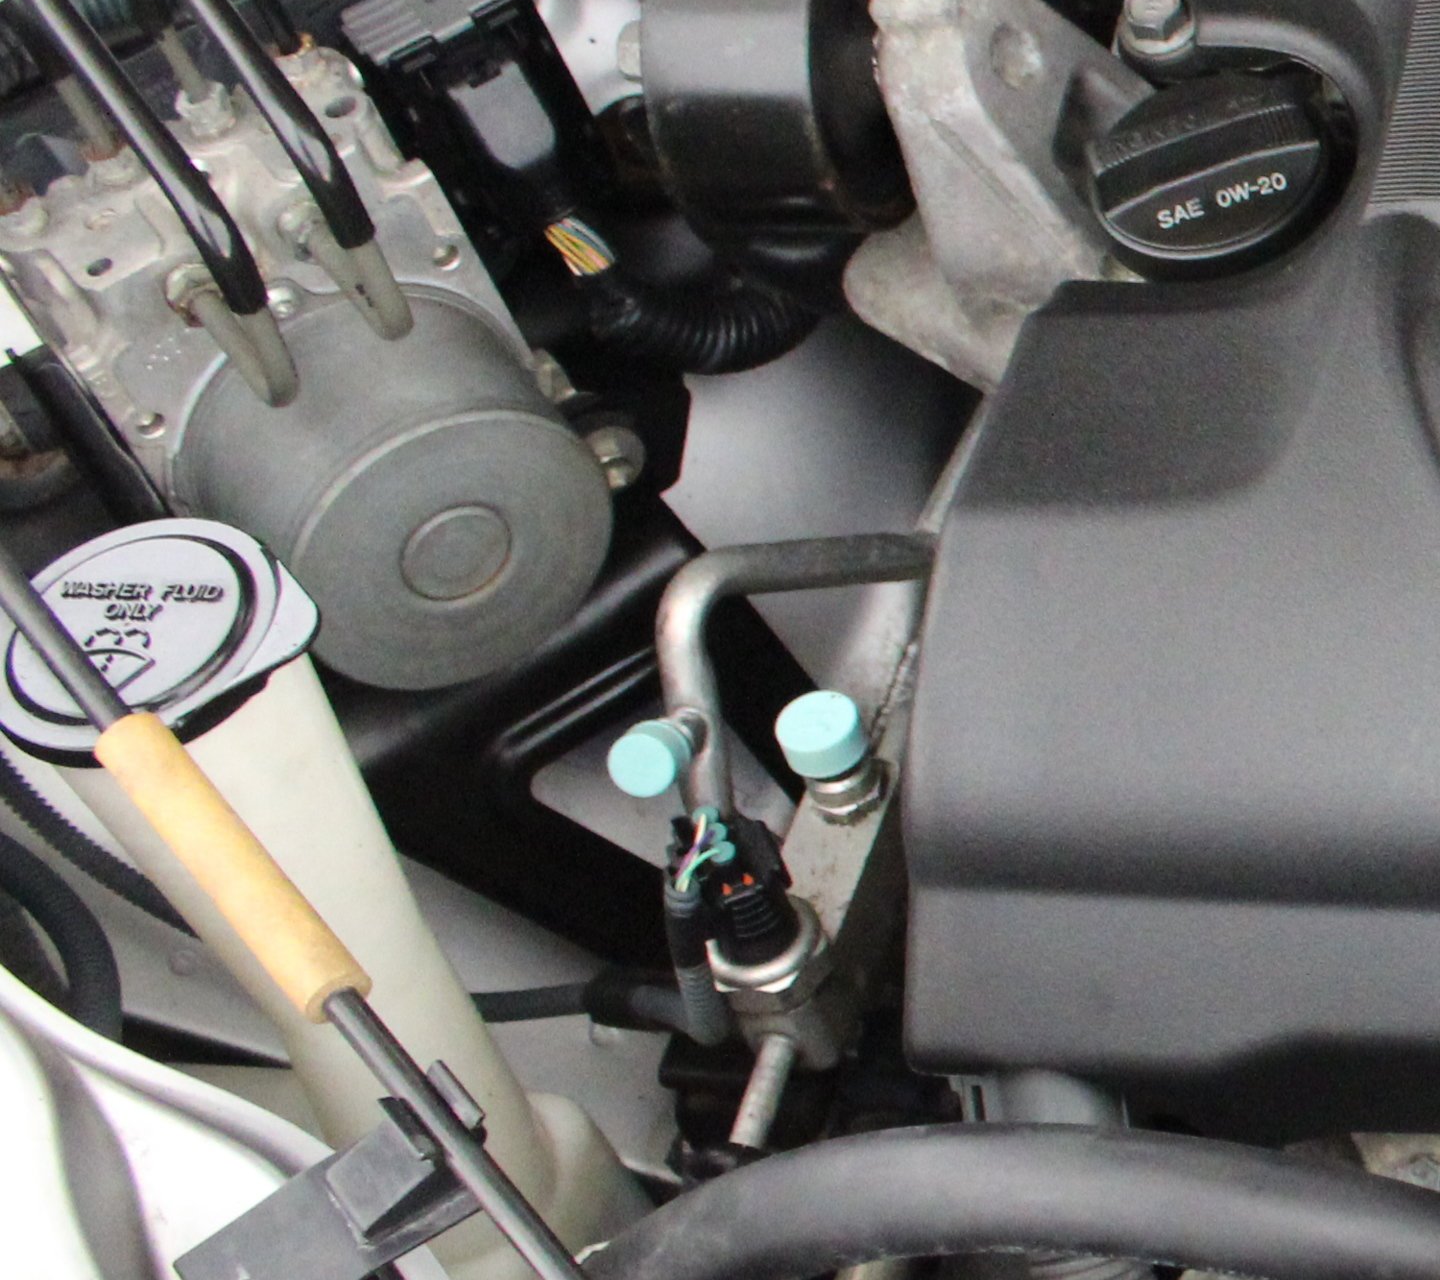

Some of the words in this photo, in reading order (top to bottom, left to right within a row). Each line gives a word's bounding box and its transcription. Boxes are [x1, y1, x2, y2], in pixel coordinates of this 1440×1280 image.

[1156, 198, 1205, 230] SAE
[1215, 171, 1288, 210] 0W-20
[60, 580, 153, 601] WASHER
[160, 583, 225, 603] FLUID
[103, 603, 164, 622] ONLY
